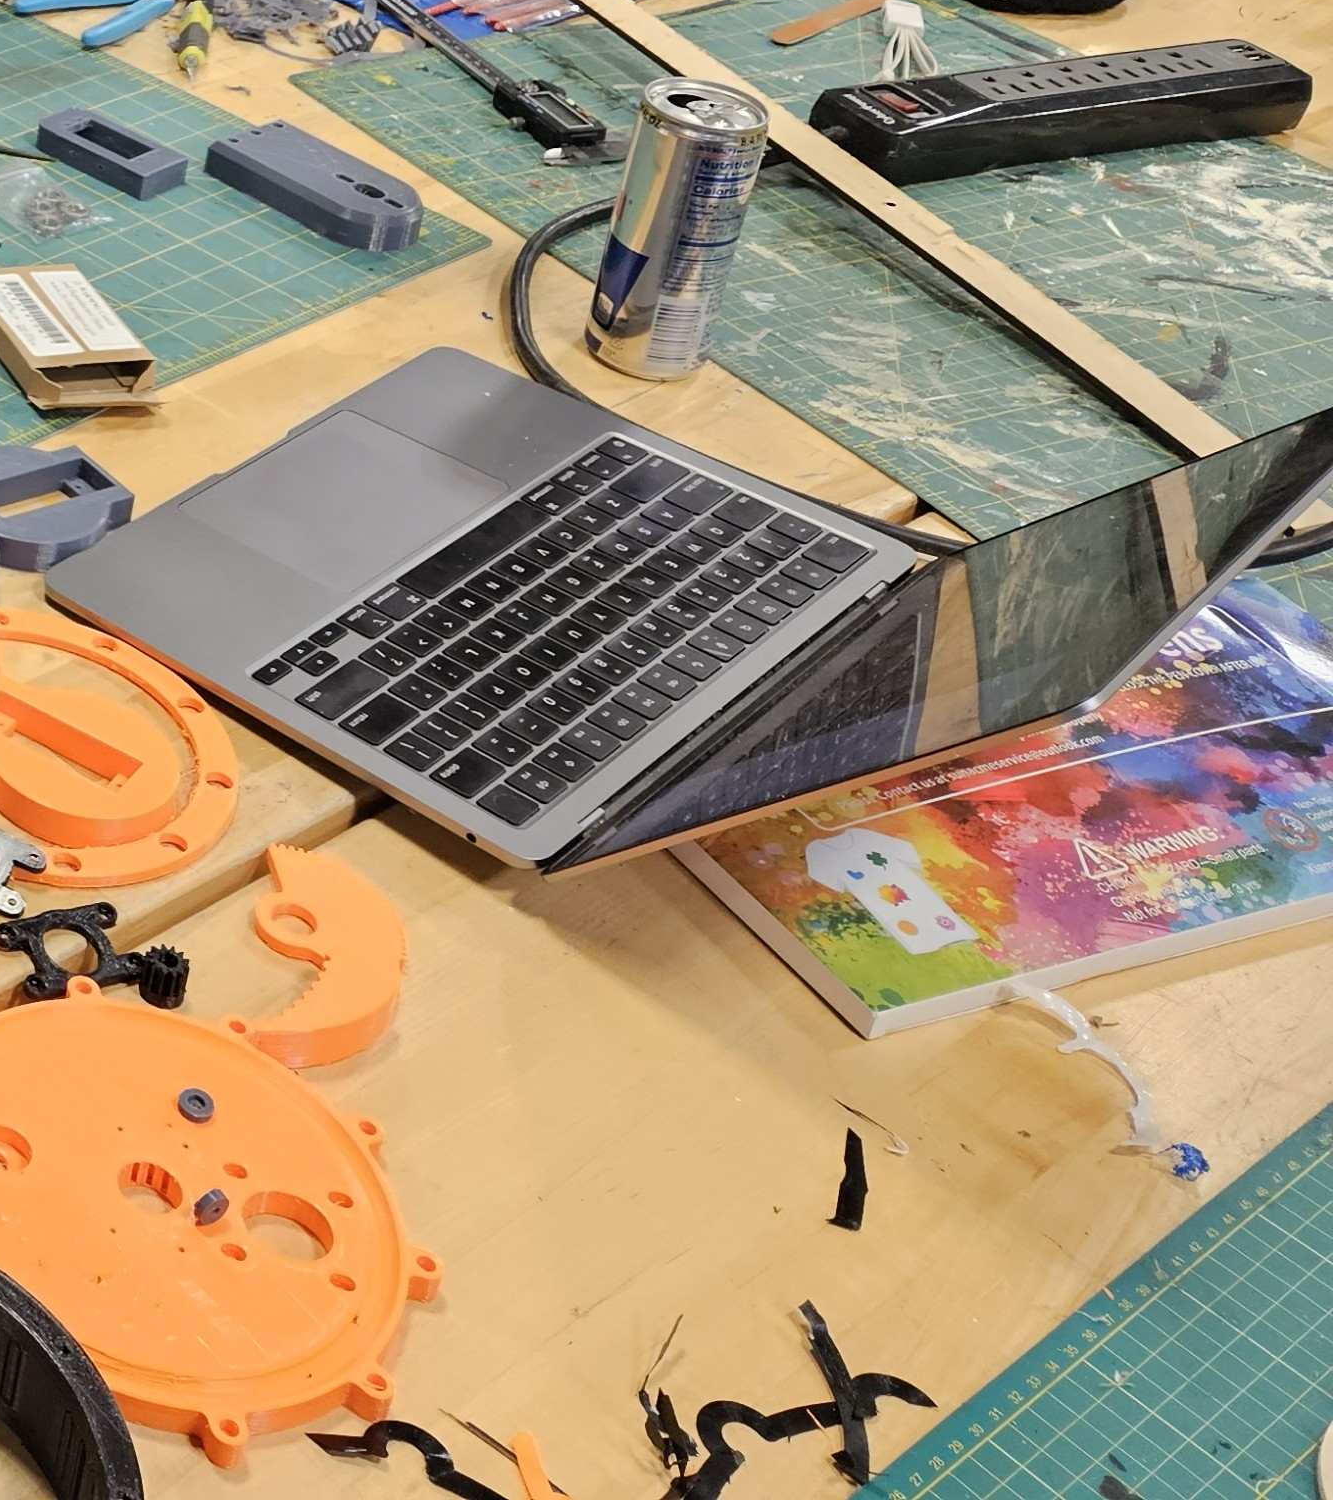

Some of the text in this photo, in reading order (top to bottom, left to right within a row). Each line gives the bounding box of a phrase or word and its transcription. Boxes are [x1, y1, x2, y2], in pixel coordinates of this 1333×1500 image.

[699, 159, 755, 171] Nutrition
[693, 184, 745, 196] Calories
[1158, 626, 1224, 658] ens
[1146, 670, 1167, 686] THE
[1166, 668, 1191, 683] PEN
[1189, 662, 1221, 680] COVER
[1219, 659, 1249, 675] AFTER
[877, 781, 922, 801] Contact
[921, 778, 936, 790] us
[934, 773, 949, 786] at
[1122, 825, 1226, 863] WARNING:
[1097, 874, 1143, 895] CHOKIN
[1239, 842, 1269, 861] parts.
[1123, 906, 1144, 924] Not
[1143, 902, 1162, 918] for
[1233, 882, 1244, 895] 3
[1244, 878, 1263, 896] yrs
[909, 1471, 925, 1488] 27
[928, 1455, 946, 1472] 28
[948, 1439, 965, 1455] 29
[968, 1423, 985, 1438] 30
[988, 1407, 1005, 1421] 31
[1007, 1390, 1025, 1405] 32
[1025, 1375, 1042, 1389] 33
[1044, 1359, 1061, 1374] 34
[1062, 1343, 1080, 1358] 35
[1081, 1328, 1098, 1343] 36
[1171, 1255, 1186, 1268] 41
[1188, 1241, 1204, 1253] 42
